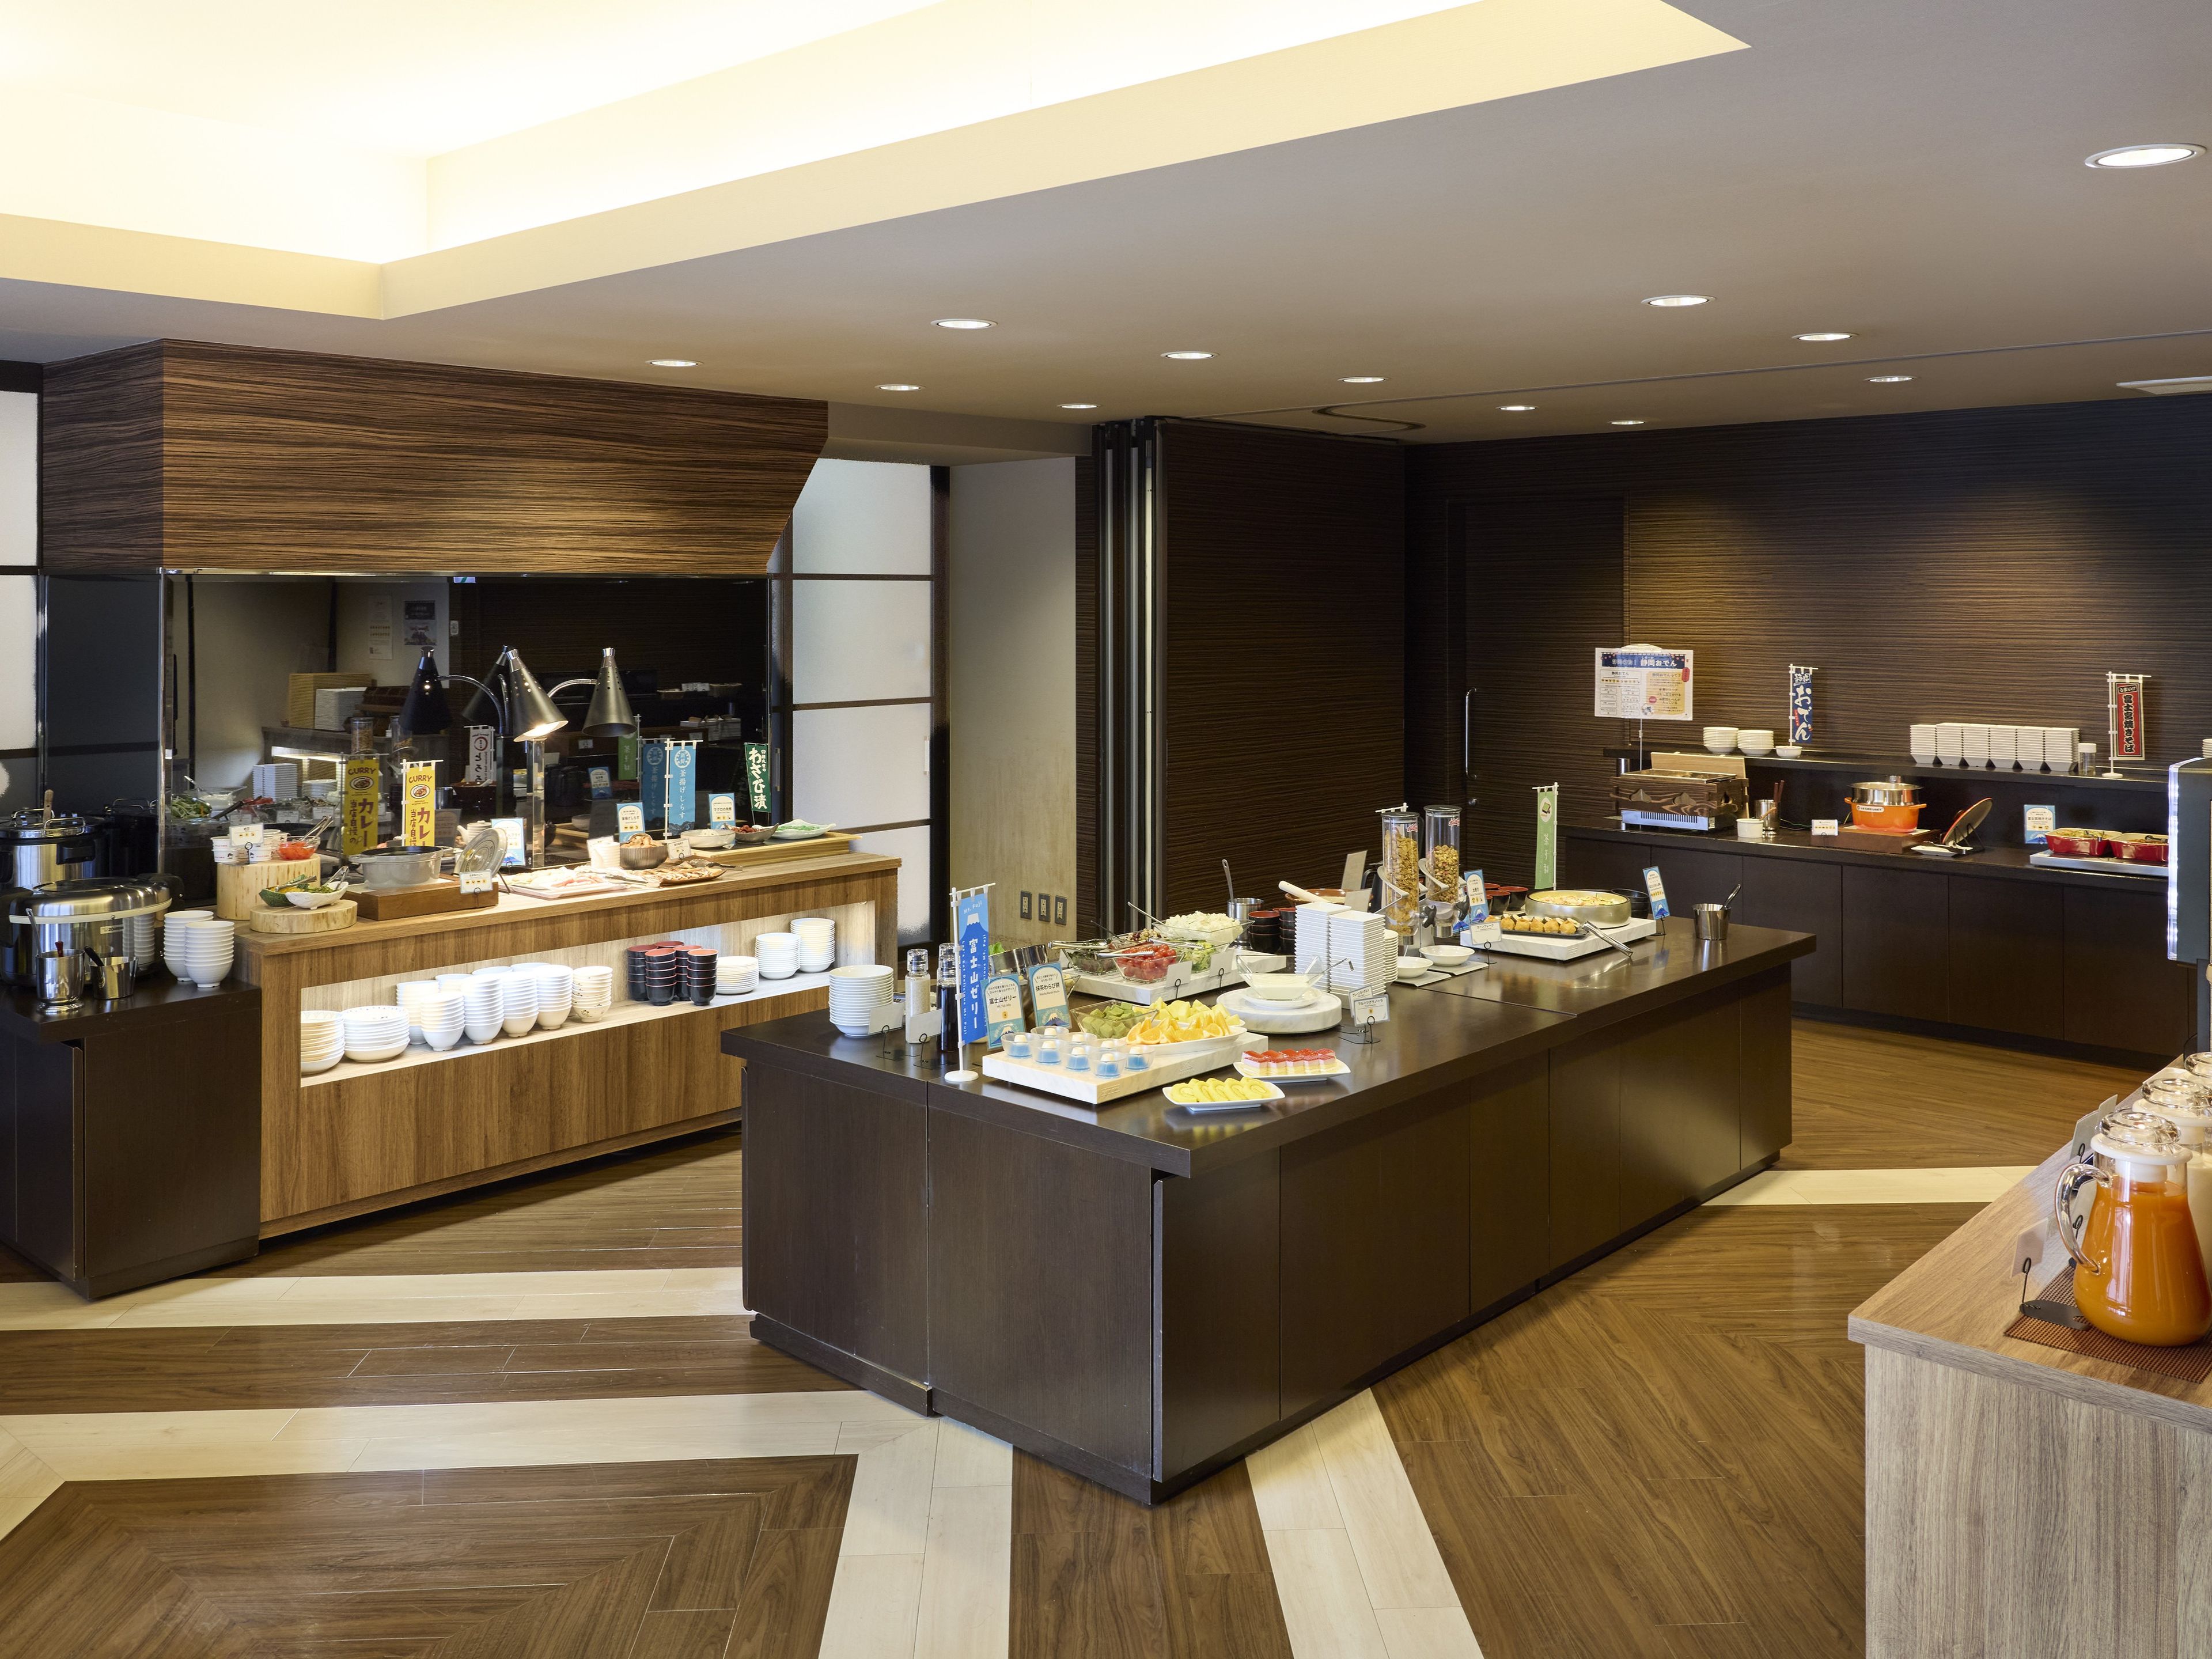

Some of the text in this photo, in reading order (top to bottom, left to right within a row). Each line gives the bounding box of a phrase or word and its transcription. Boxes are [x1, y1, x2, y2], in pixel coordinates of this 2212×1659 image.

[1794, 685, 1812, 741] おでん
[2123, 694, 2135, 753] 富士宮焼きそば
[348, 767, 376, 775] CURRY
[408, 775, 433, 784] CURRY
[679, 770, 687, 820] 釜揚げしらす
[748, 747, 767, 809] わさび漬
[358, 798, 374, 847] カレー
[972, 900, 982, 909] Fuji
[969, 938, 979, 1029] 富士山ゼリー
[989, 995, 1017, 1005] 富士山ゼリー
[1036, 982, 1060, 992] 抹茶わらび餅
